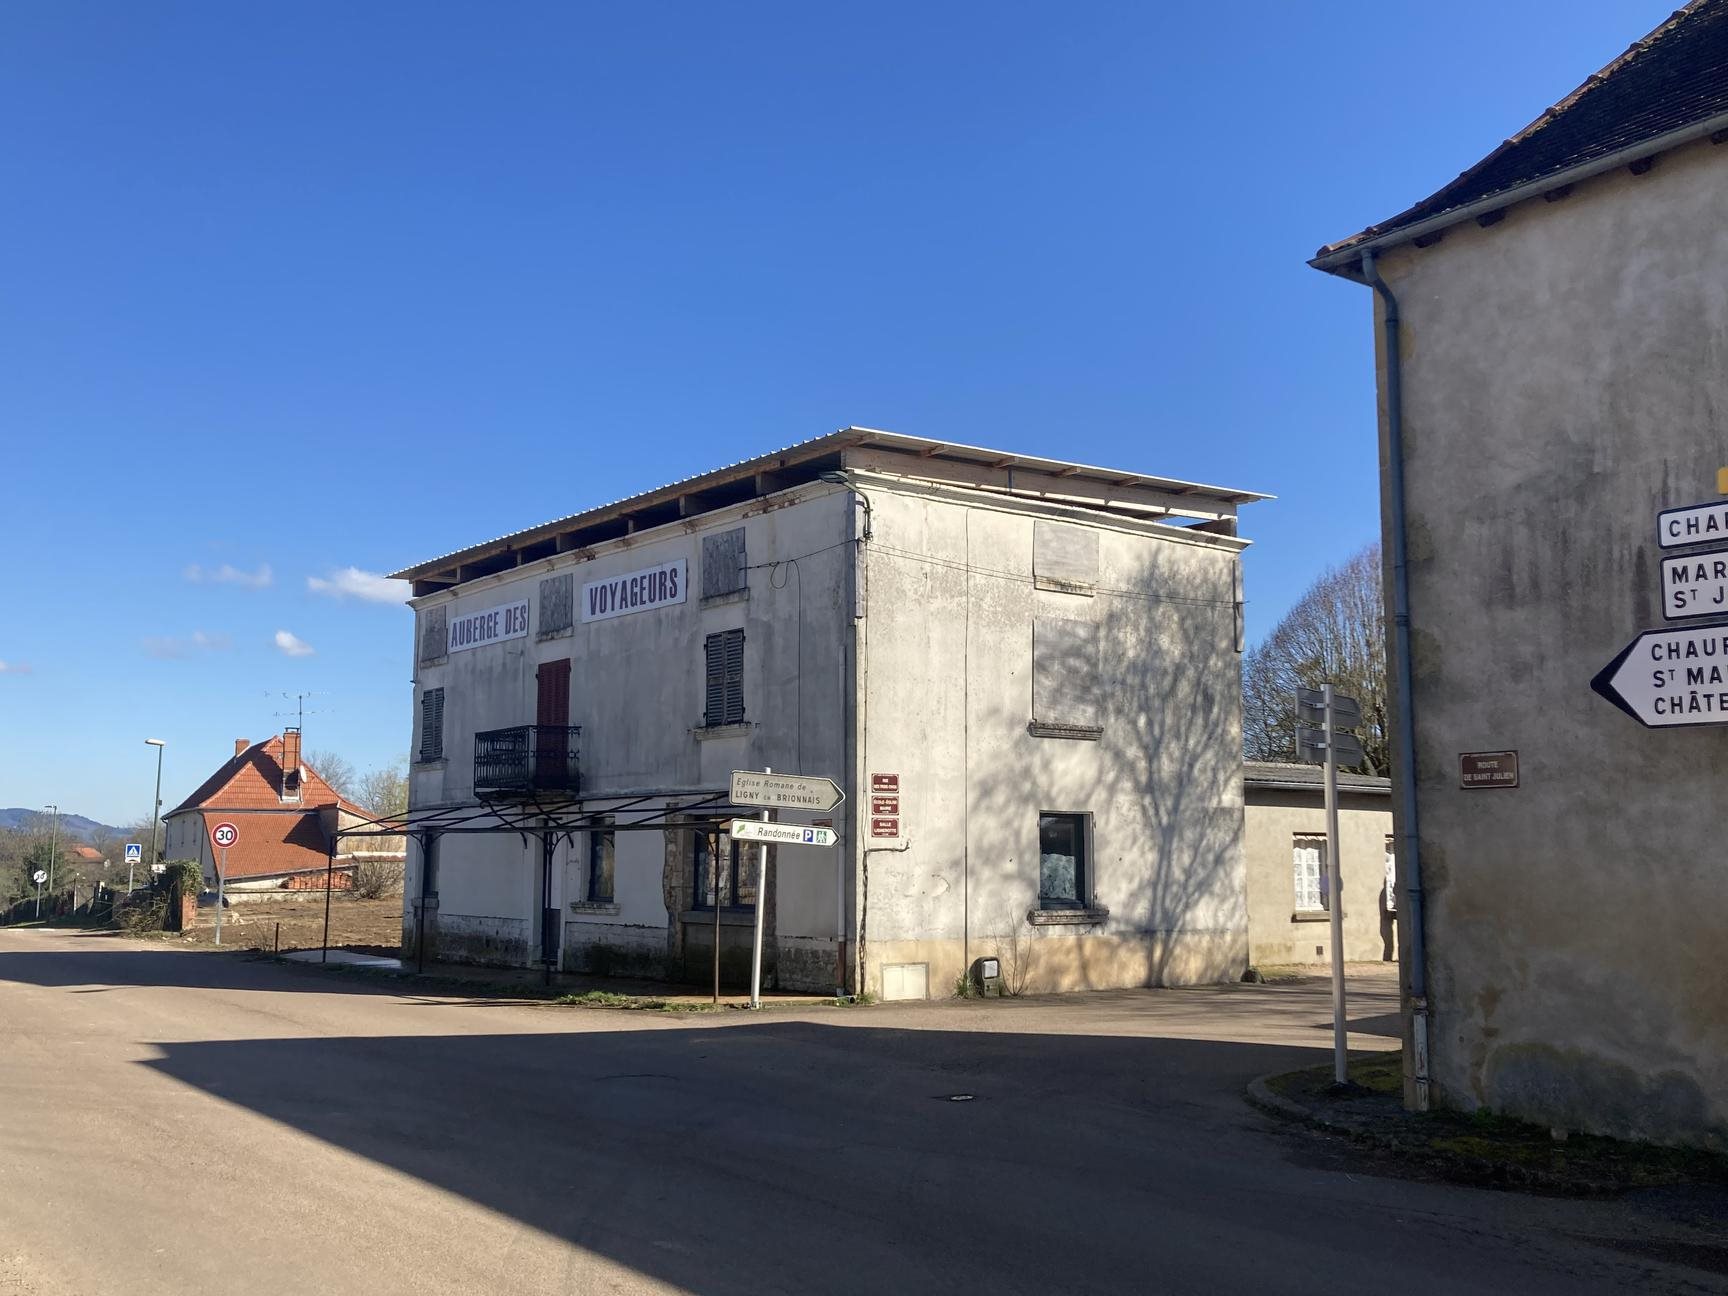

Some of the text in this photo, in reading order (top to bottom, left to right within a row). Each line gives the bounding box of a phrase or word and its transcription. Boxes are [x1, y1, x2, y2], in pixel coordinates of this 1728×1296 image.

[1669, 511, 1728, 538] CHA
[589, 567, 679, 616] VOYAGEURS
[450, 604, 527, 648] AUBERGE DES
[1687, 664, 1728, 686] MA
[1477, 760, 1499, 769] ROUTE
[1463, 771, 1514, 781] DE SAINT JULIEN
[763, 780, 795, 791] Romane
[735, 791, 760, 800] LIGNY
[776, 793, 821, 805] BRIONNAIS
[217, 830, 233, 841] 30
[757, 827, 801, 840] Randonnée
